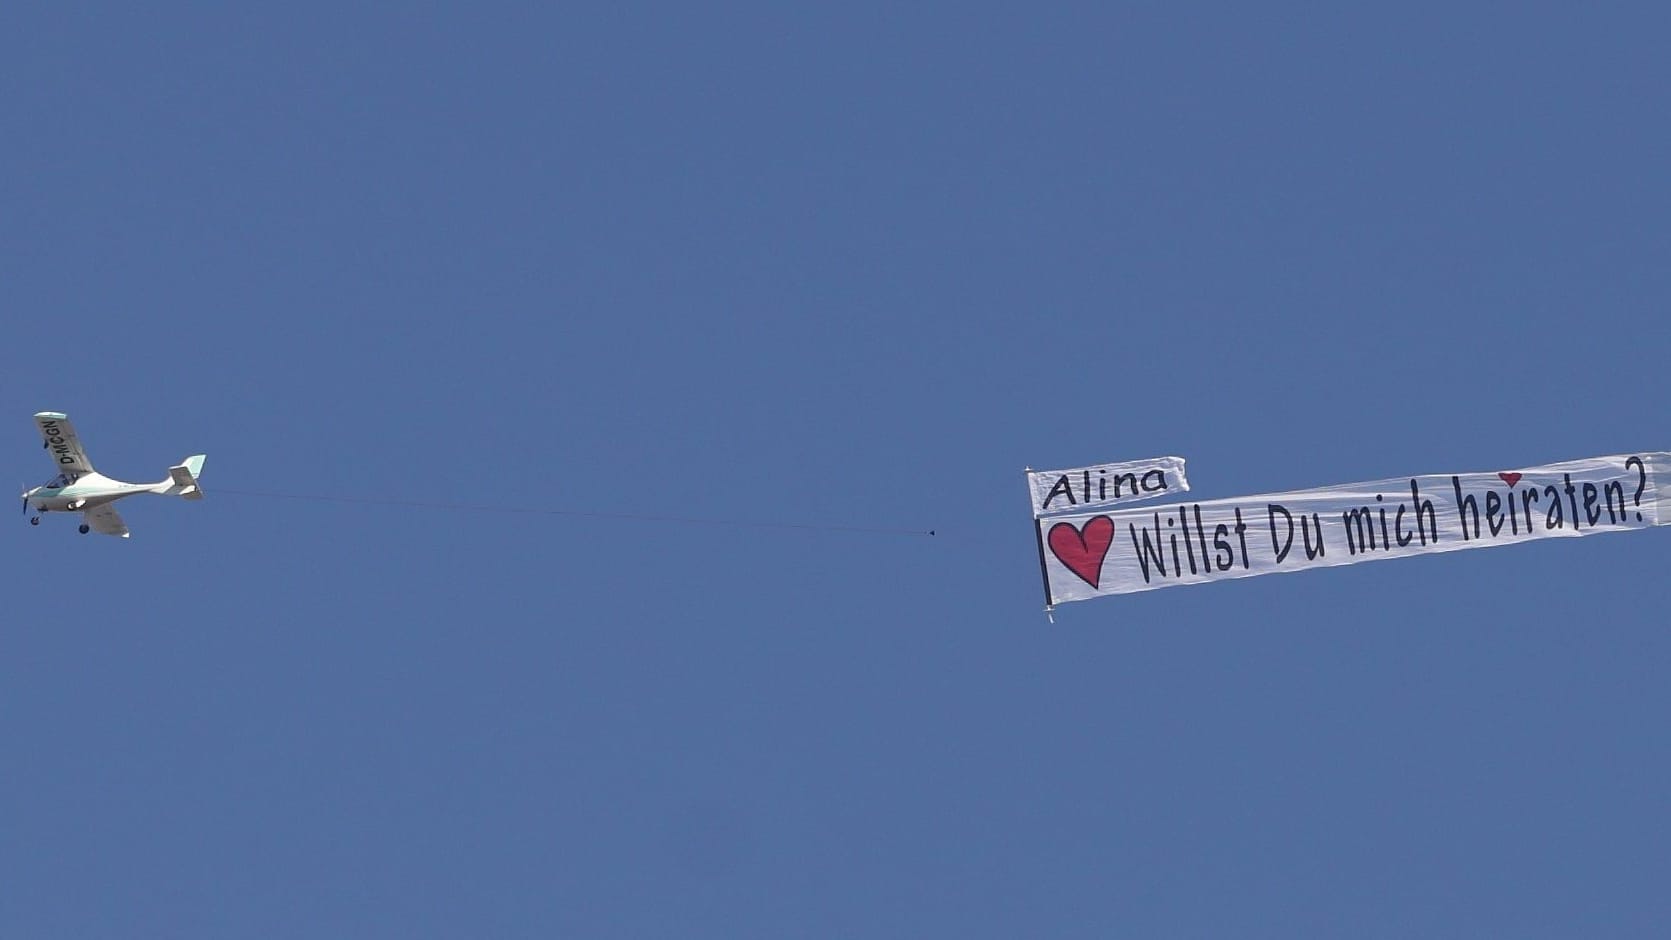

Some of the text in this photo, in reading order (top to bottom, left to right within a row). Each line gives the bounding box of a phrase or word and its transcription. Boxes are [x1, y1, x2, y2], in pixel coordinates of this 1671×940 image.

[42, 420, 75, 465] D-MCGN
[1042, 469, 1168, 509] Alina
[1129, 456, 1647, 584] Willst Du mich heiraten?
